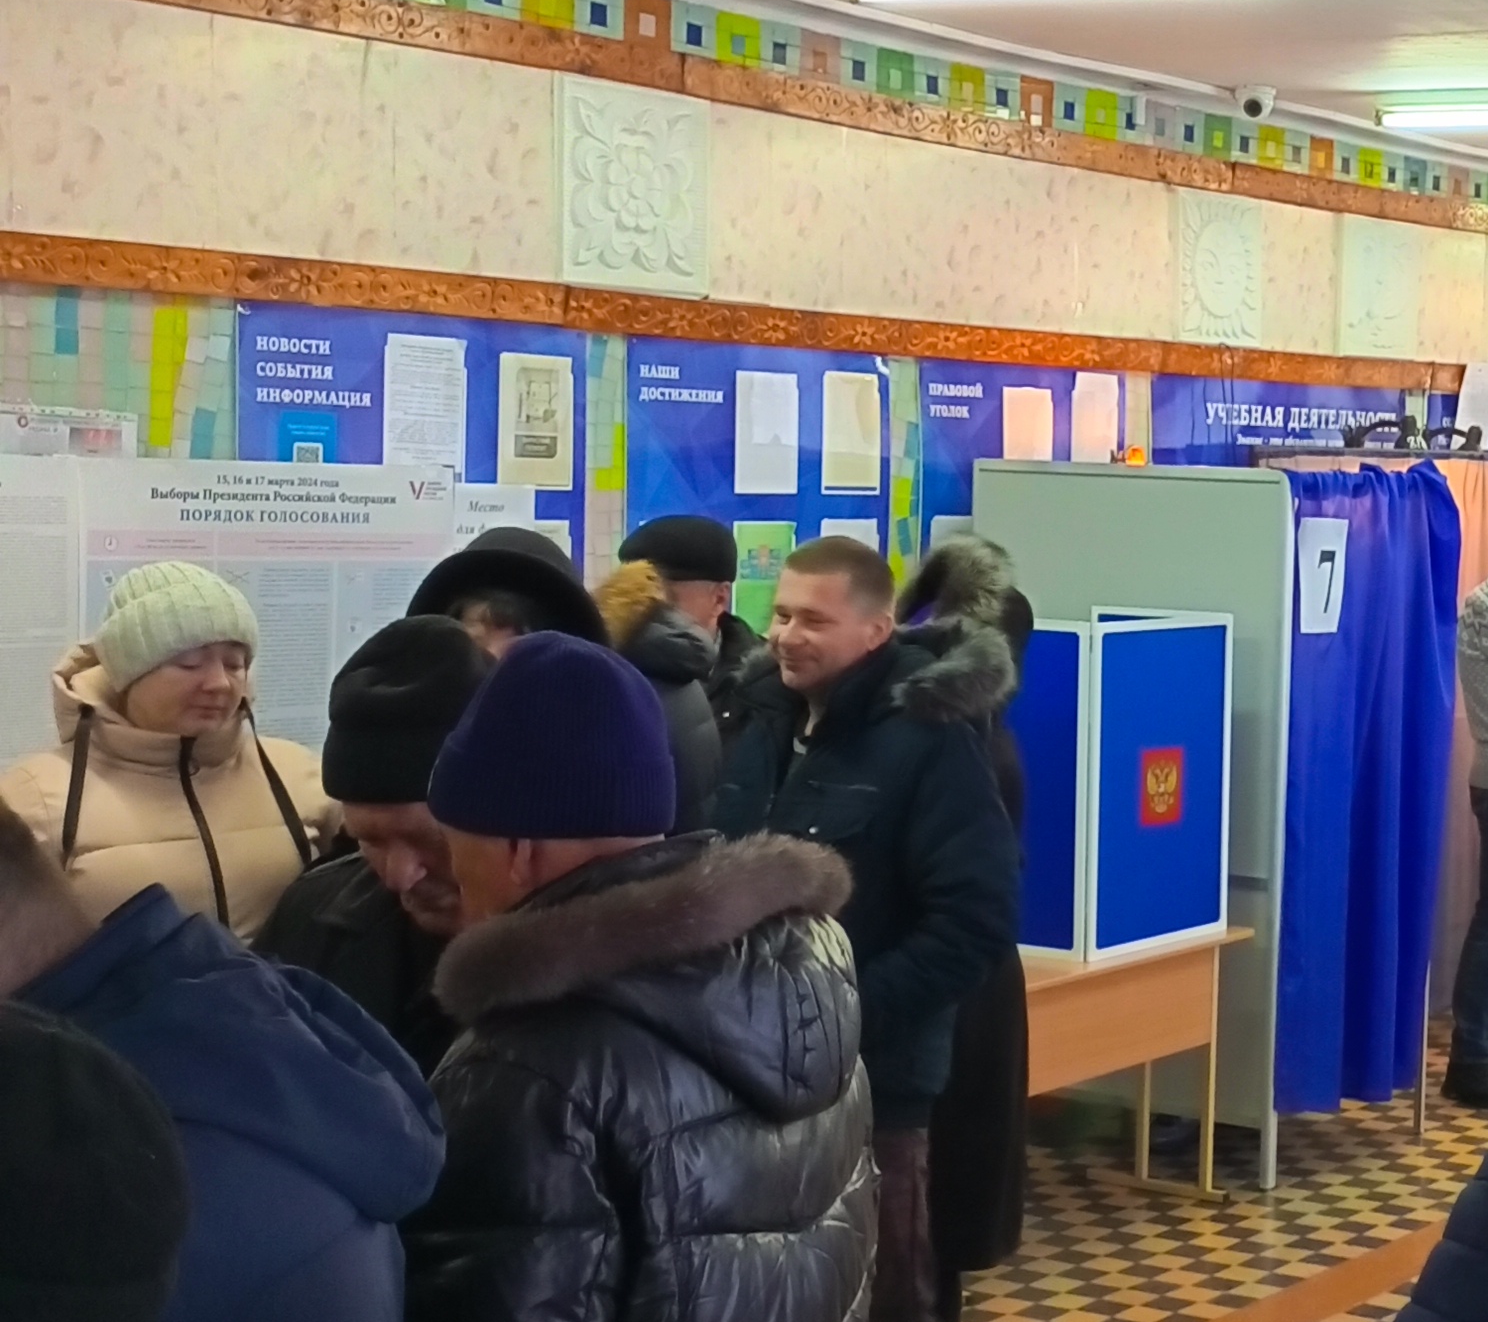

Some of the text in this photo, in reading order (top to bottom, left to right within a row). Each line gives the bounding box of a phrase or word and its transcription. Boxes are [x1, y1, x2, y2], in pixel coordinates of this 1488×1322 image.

[256, 335, 331, 355] НОВОСТИ
[256, 361, 333, 380] СОБЫТИЯ
[639, 364, 680, 380] НАШИ
[256, 388, 372, 409] ИНФОРМАЦИЯ
[639, 386, 724, 404] ДОСТИЖЕНИЯ
[928, 382, 983, 398] ПРАВОВОЙ
[929, 404, 970, 419] УГОЛОК
[1206, 402, 1285, 428] УЧЕБНАЯ
[233, 475, 243, 485] 16
[255, 476, 265, 485] 17
[267, 478, 295, 488] марта
[297, 477, 318, 487] 2024
[320, 480, 339, 488] года
[150, 487, 397, 507] Выборы Президента Российской Федерации
[467, 500, 504, 513] Место
[180, 509, 370, 524] ПОРЯДОК ГОЛОСОВАНИЯ
[1317, 550, 1337, 614] 7
